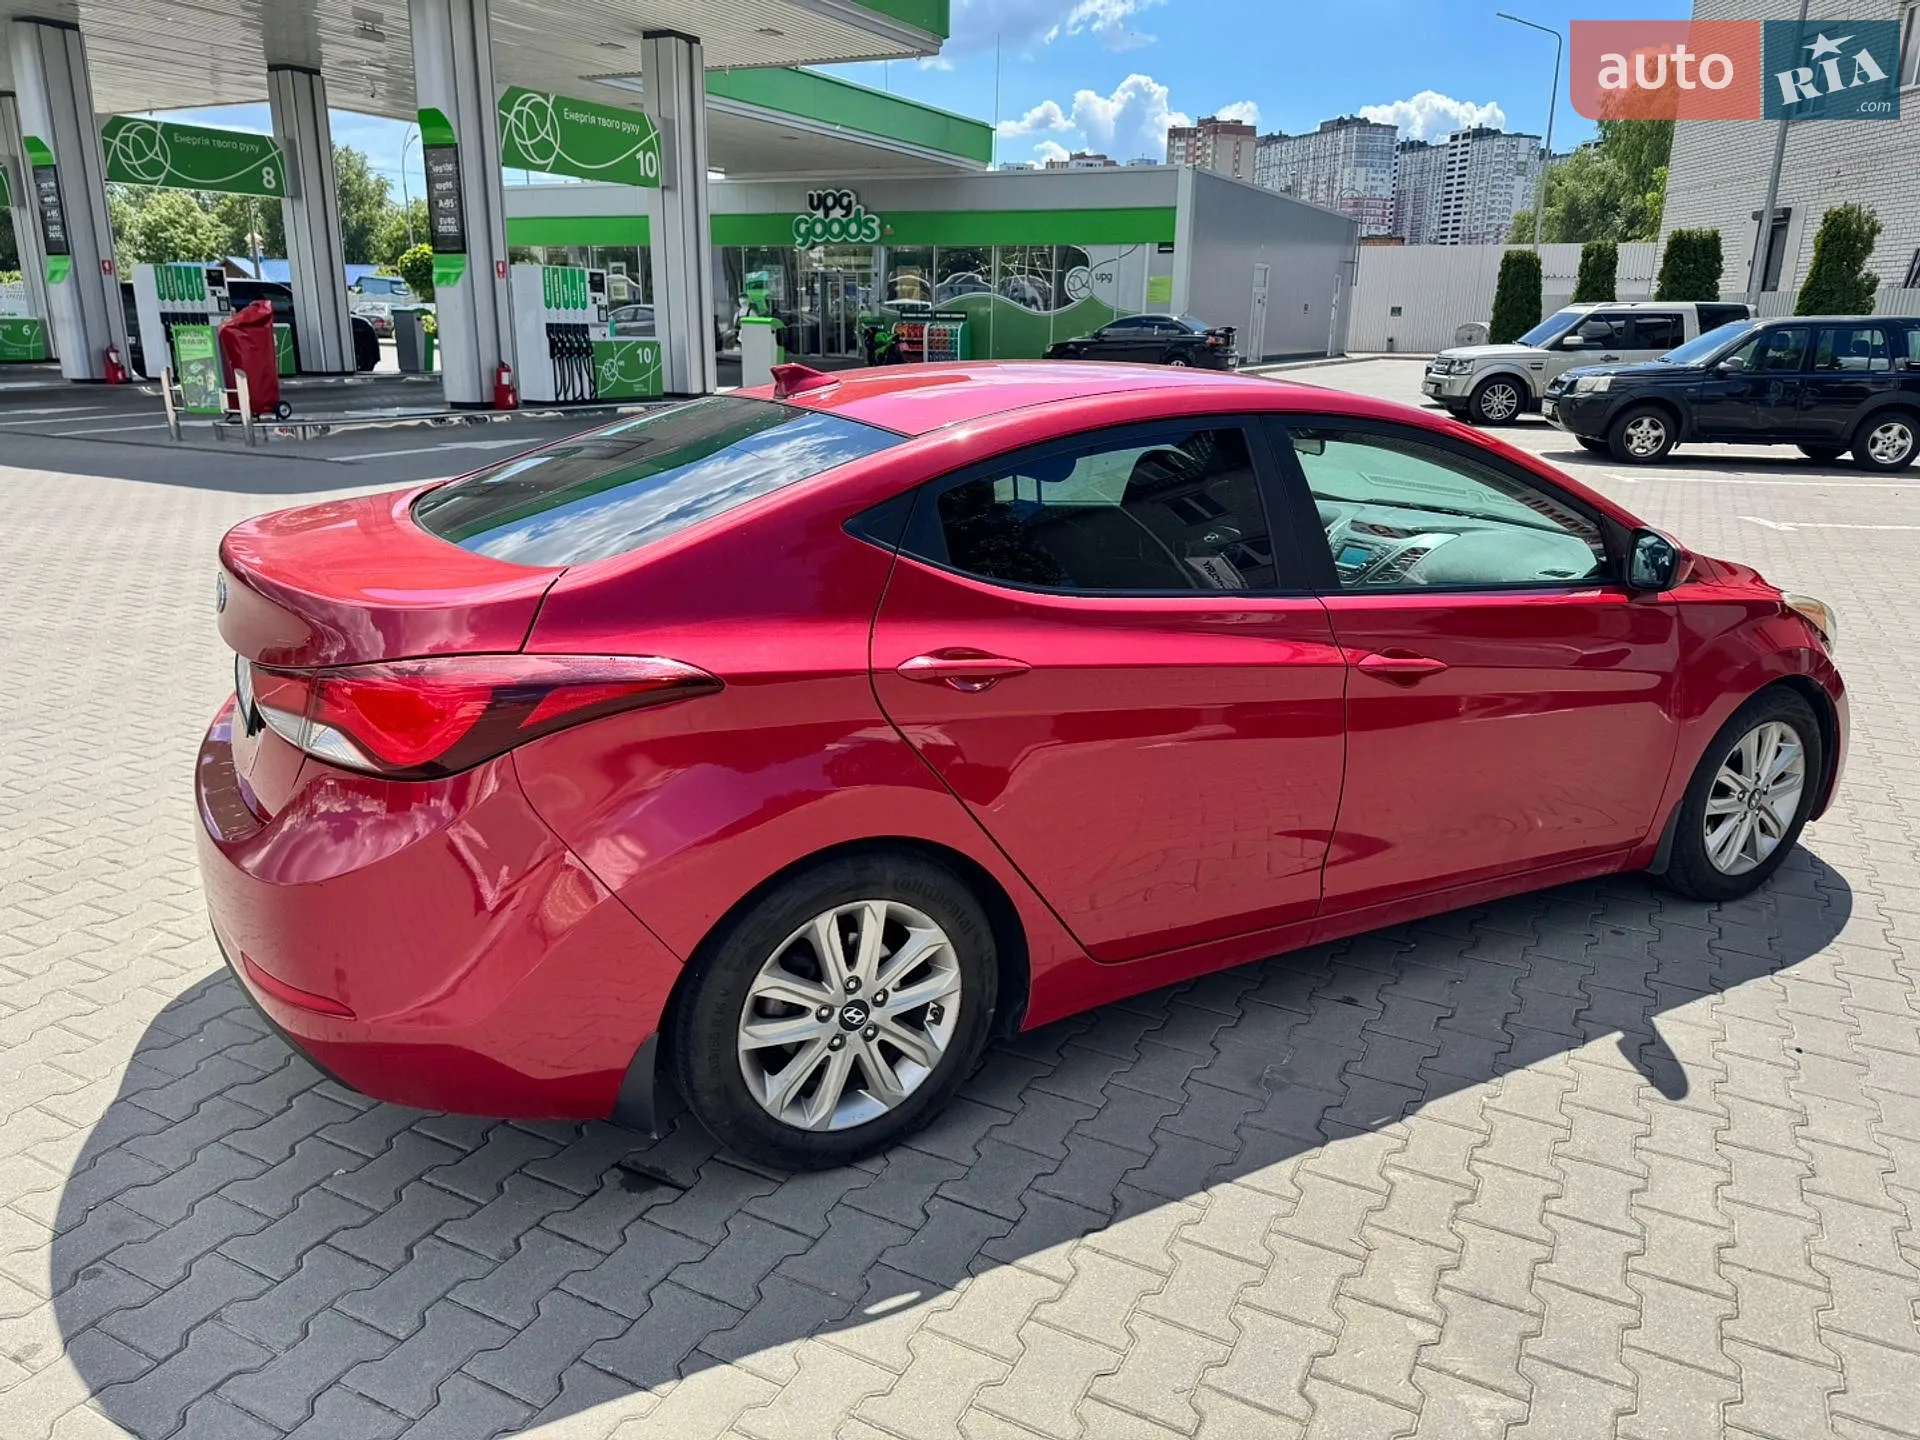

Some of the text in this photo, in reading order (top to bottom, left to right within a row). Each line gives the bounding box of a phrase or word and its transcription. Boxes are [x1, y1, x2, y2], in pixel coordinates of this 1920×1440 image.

[563, 108, 640, 135] Енергія твого руху
[173, 132, 260, 153] Енергія твого руху
[636, 149, 657, 178] 10
[262, 166, 276, 189] 8
[807, 190, 854, 219] upg
[793, 206, 878, 248] goods
[1095, 272, 1113, 283] upg
[22, 324, 31, 336] 6
[636, 347, 652, 364] 10
[893, 875, 976, 934] Continental
